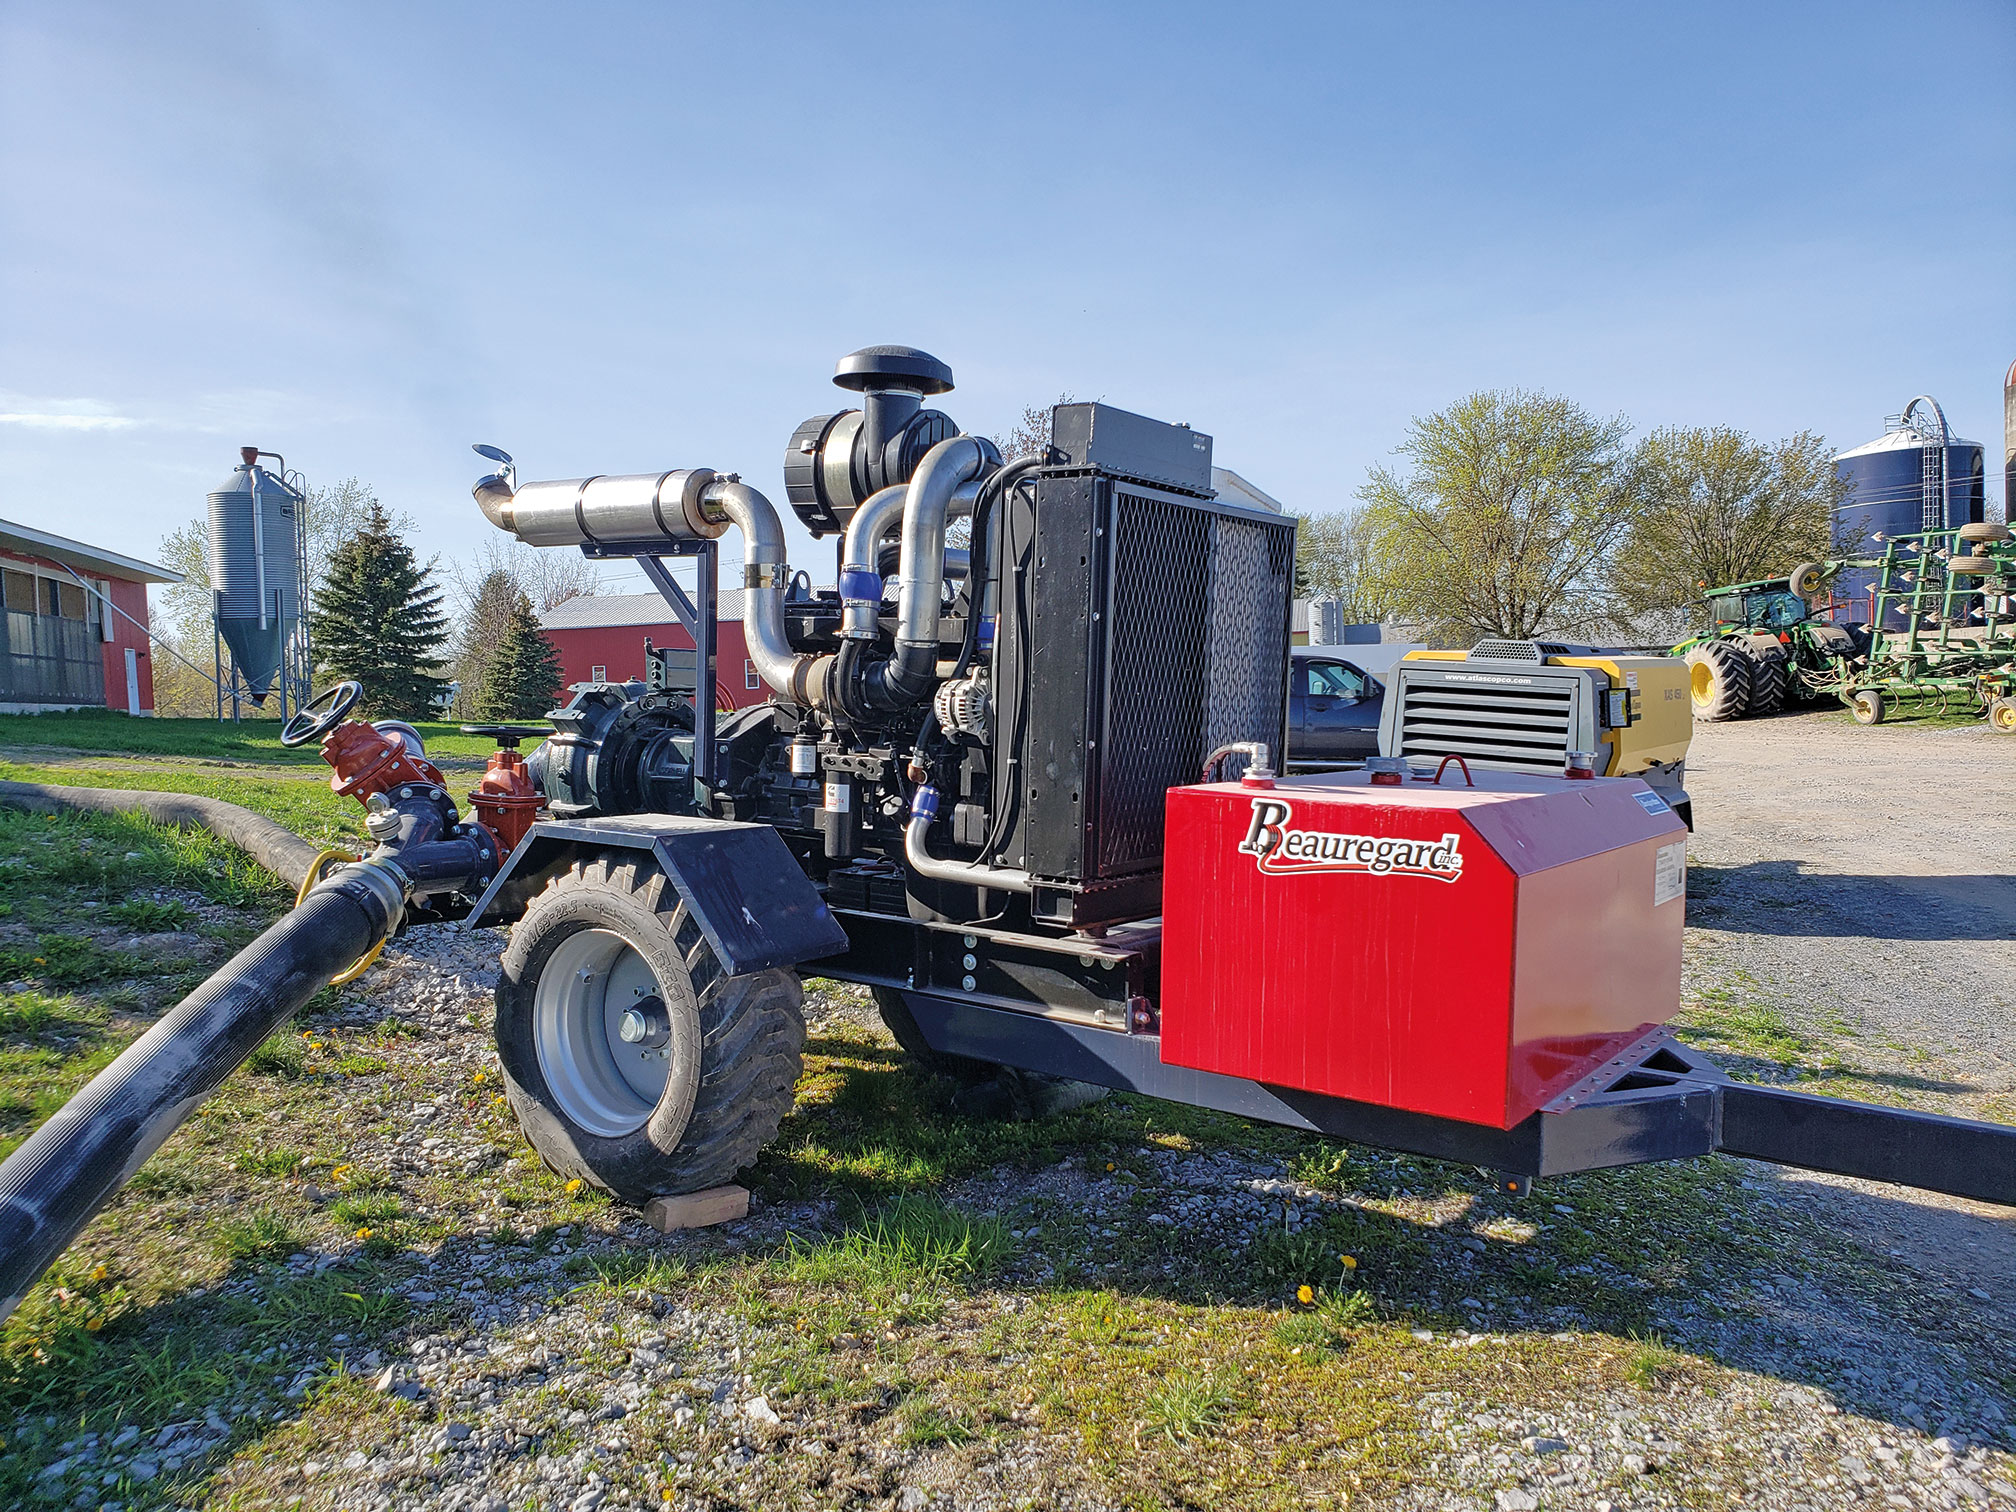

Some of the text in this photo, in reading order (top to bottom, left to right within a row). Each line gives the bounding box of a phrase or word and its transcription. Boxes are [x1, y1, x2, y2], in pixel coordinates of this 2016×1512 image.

[1444, 673, 1532, 685] www.atlascopco.com
[1242, 801, 1460, 872] Beauregard inc.
[520, 900, 578, 955] 400/55-22.5
